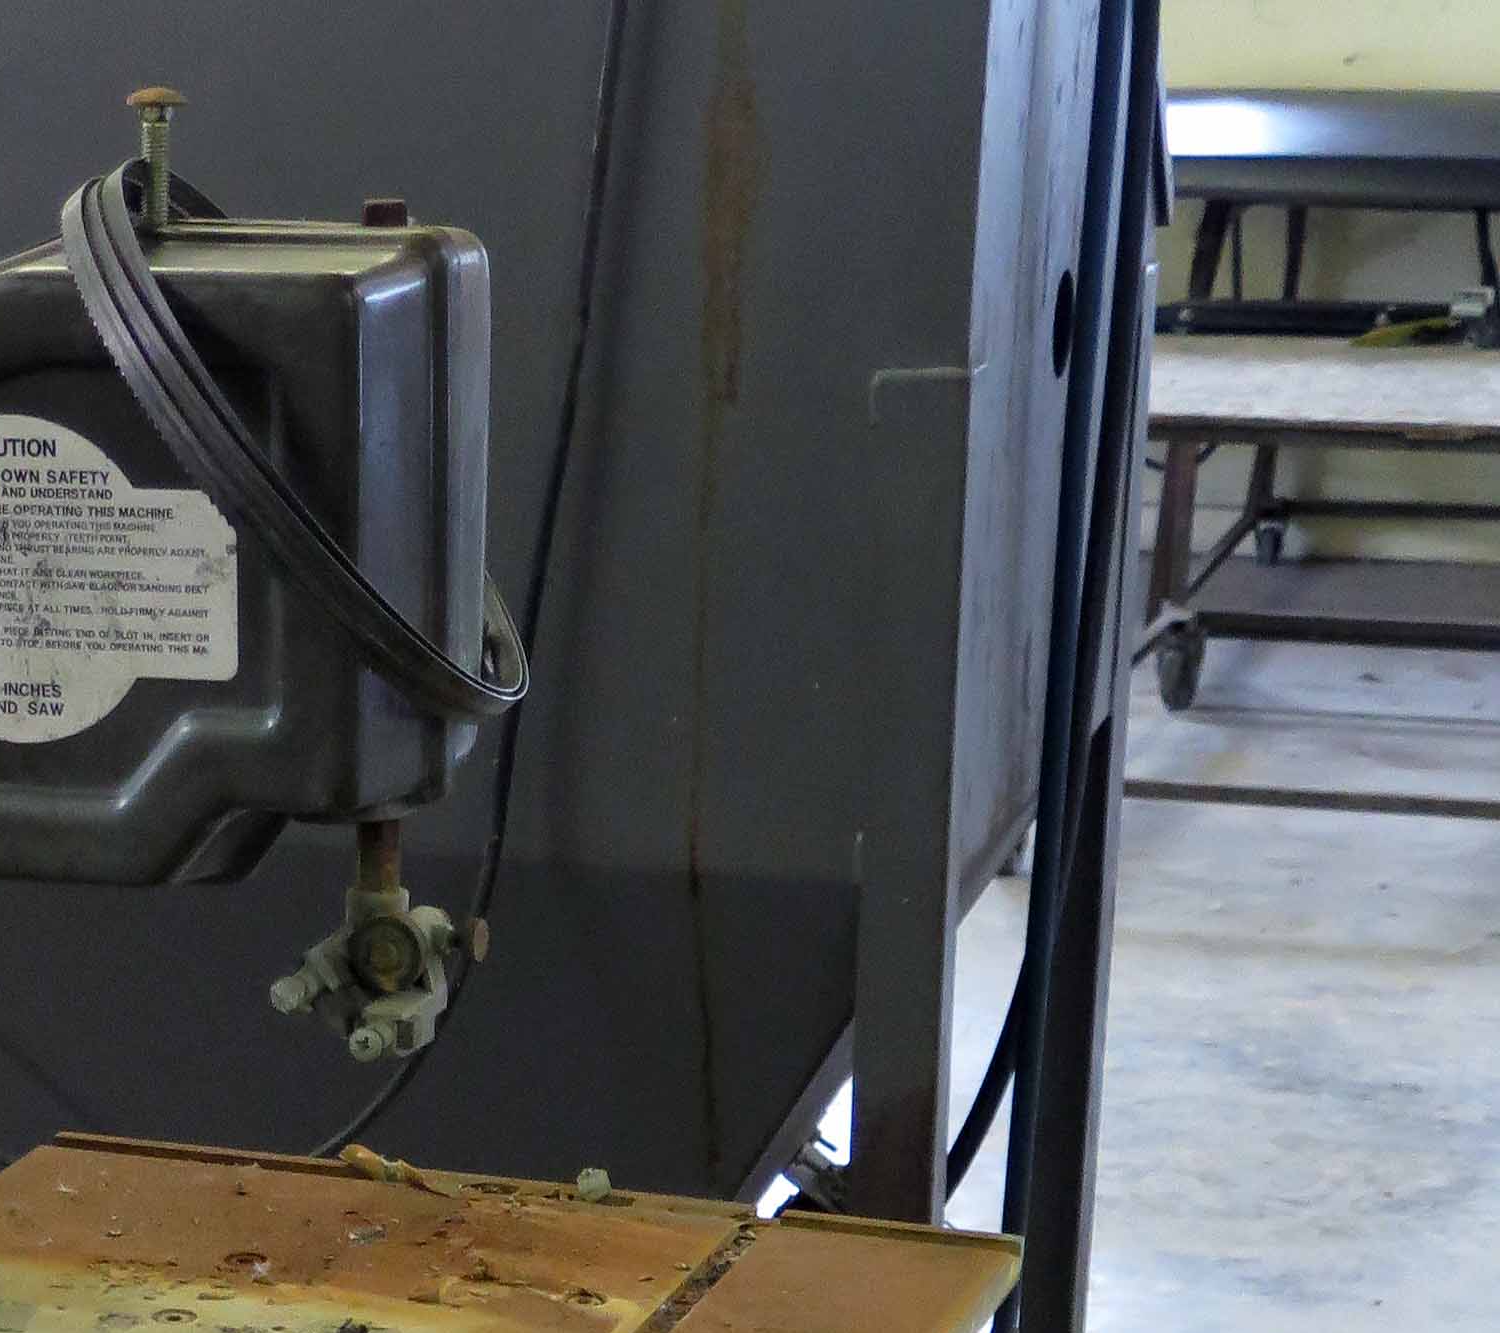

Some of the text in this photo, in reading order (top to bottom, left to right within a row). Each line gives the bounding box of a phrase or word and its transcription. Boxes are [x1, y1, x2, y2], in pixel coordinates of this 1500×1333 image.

[1, 468, 40, 484] OWN
[46, 470, 110, 486] SAFETY
[1, 487, 26, 499] AND
[30, 488, 113, 500] UNDERSTAND
[13, 504, 83, 517] OPERATING
[88, 505, 115, 518] THIS
[118, 506, 174, 521] MACHINE
[27, 701, 65, 717] SAW
